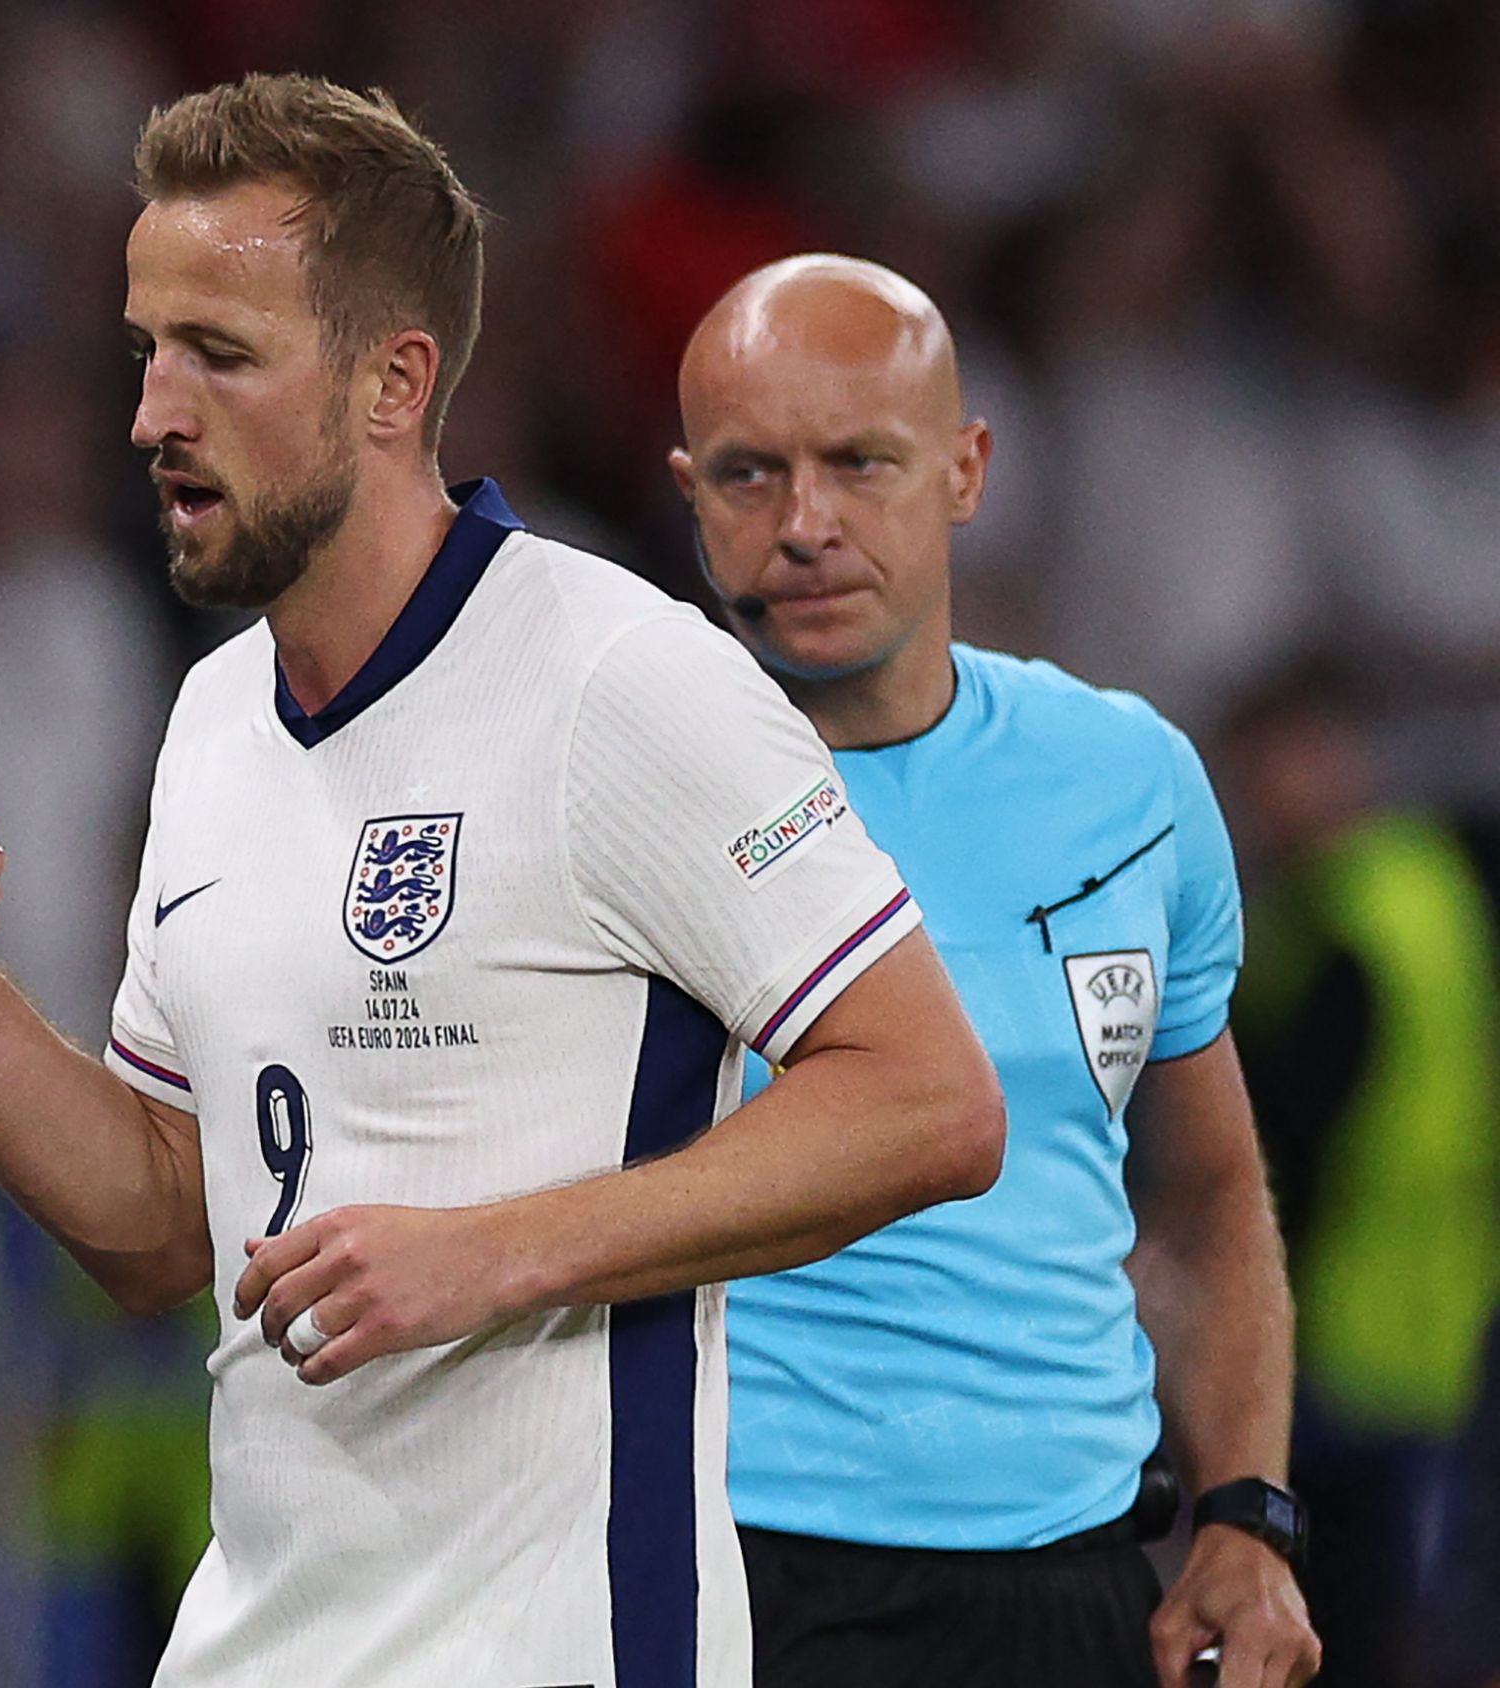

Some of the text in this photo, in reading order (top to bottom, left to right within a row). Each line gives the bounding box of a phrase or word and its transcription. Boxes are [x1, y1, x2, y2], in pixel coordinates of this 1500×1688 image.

[736, 782, 840, 874] FOUNDATION
[728, 827, 761, 857] UEFA
[369, 970, 408, 991] SPAIN
[1091, 972, 1142, 1001] UEFA
[365, 998, 419, 1020] 14.07.24
[328, 1023, 479, 1049] UEFA EURO 2024 FINAL
[1102, 1024, 1144, 1041] MATCH
[256, 1063, 313, 1238] 9
